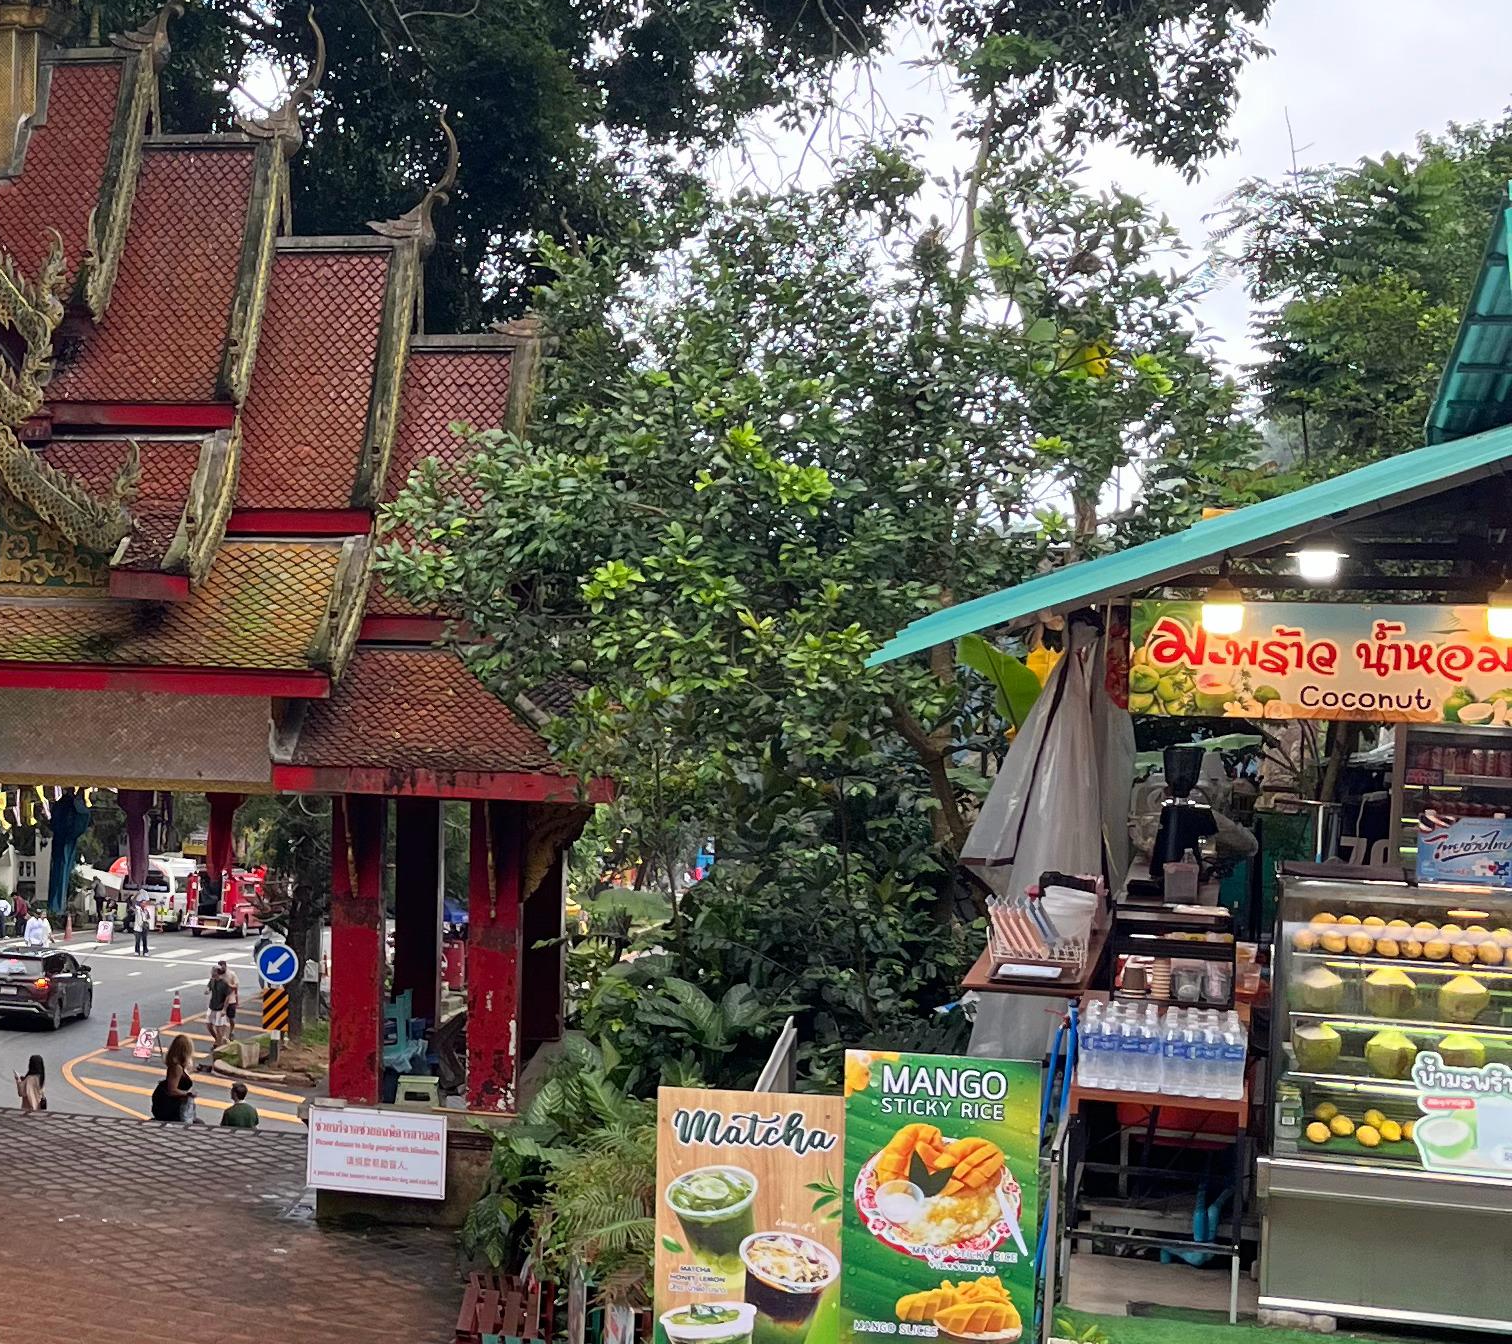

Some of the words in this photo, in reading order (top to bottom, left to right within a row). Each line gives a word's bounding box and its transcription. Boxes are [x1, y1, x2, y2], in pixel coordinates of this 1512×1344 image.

[1300, 685, 1432, 710] Coconut
[882, 1064, 1007, 1100] MANGO
[881, 1097, 952, 1117] STICKY
[961, 1102, 1005, 1121] RICE
[674, 1109, 836, 1155] Matcha
[911, 1246, 949, 1258] MANGO
[993, 1252, 1018, 1263] RICE
[680, 1265, 711, 1273] MATCHA
[699, 1275, 726, 1283] LEMON
[854, 1320, 896, 1333] MANGO
[899, 1324, 939, 1337] SLICES
